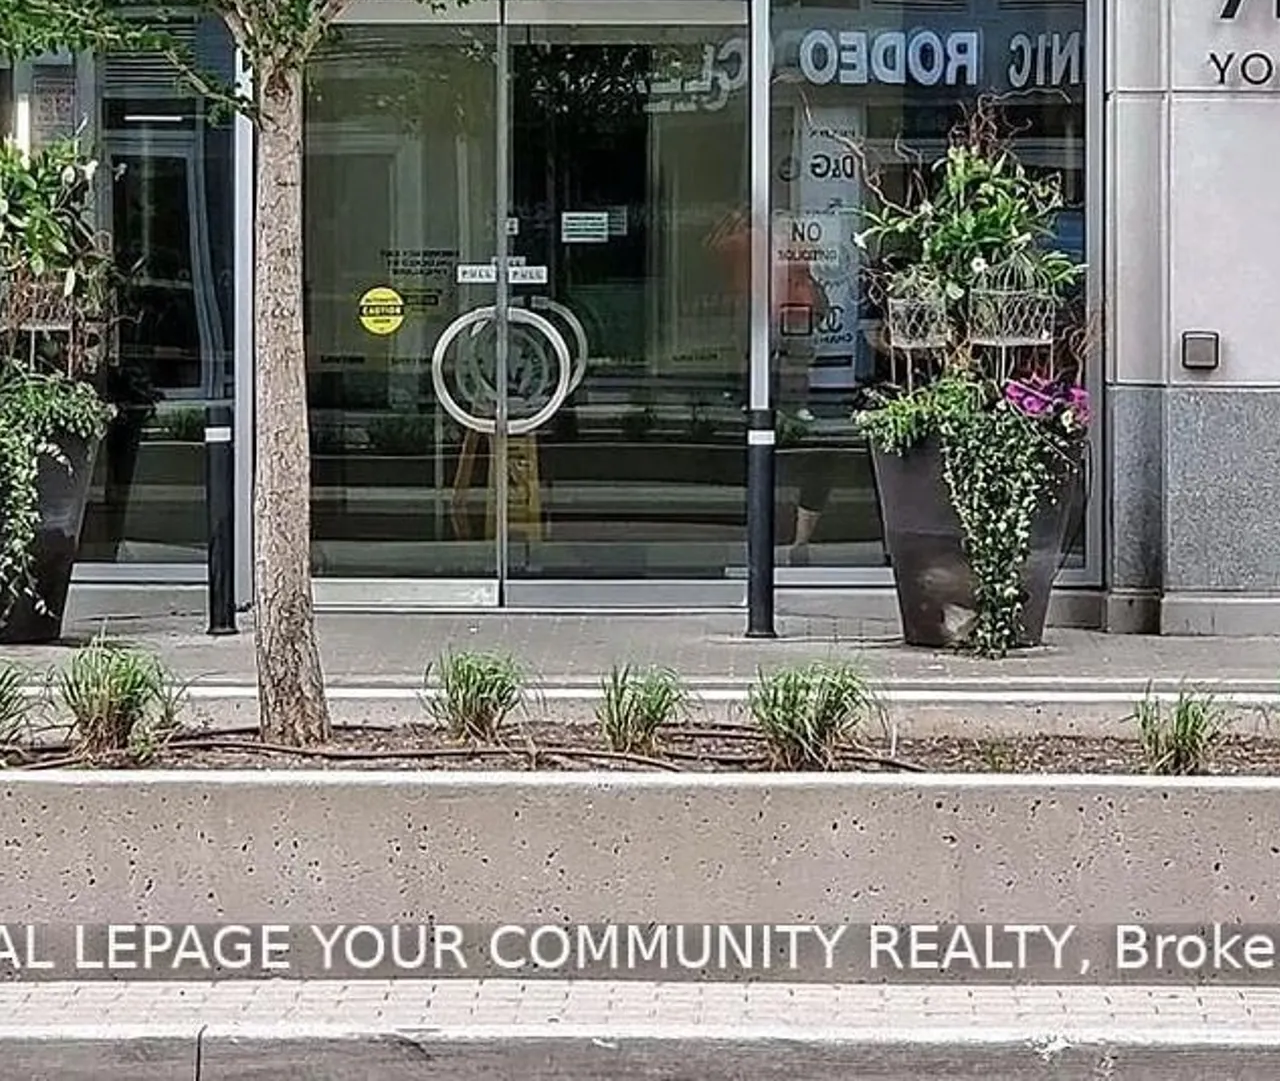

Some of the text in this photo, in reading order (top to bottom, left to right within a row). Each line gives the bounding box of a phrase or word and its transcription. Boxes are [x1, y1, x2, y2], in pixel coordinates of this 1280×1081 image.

[461, 270, 493, 279] PULL
[512, 270, 544, 279] PULL
[361, 305, 402, 316] CAUTION
